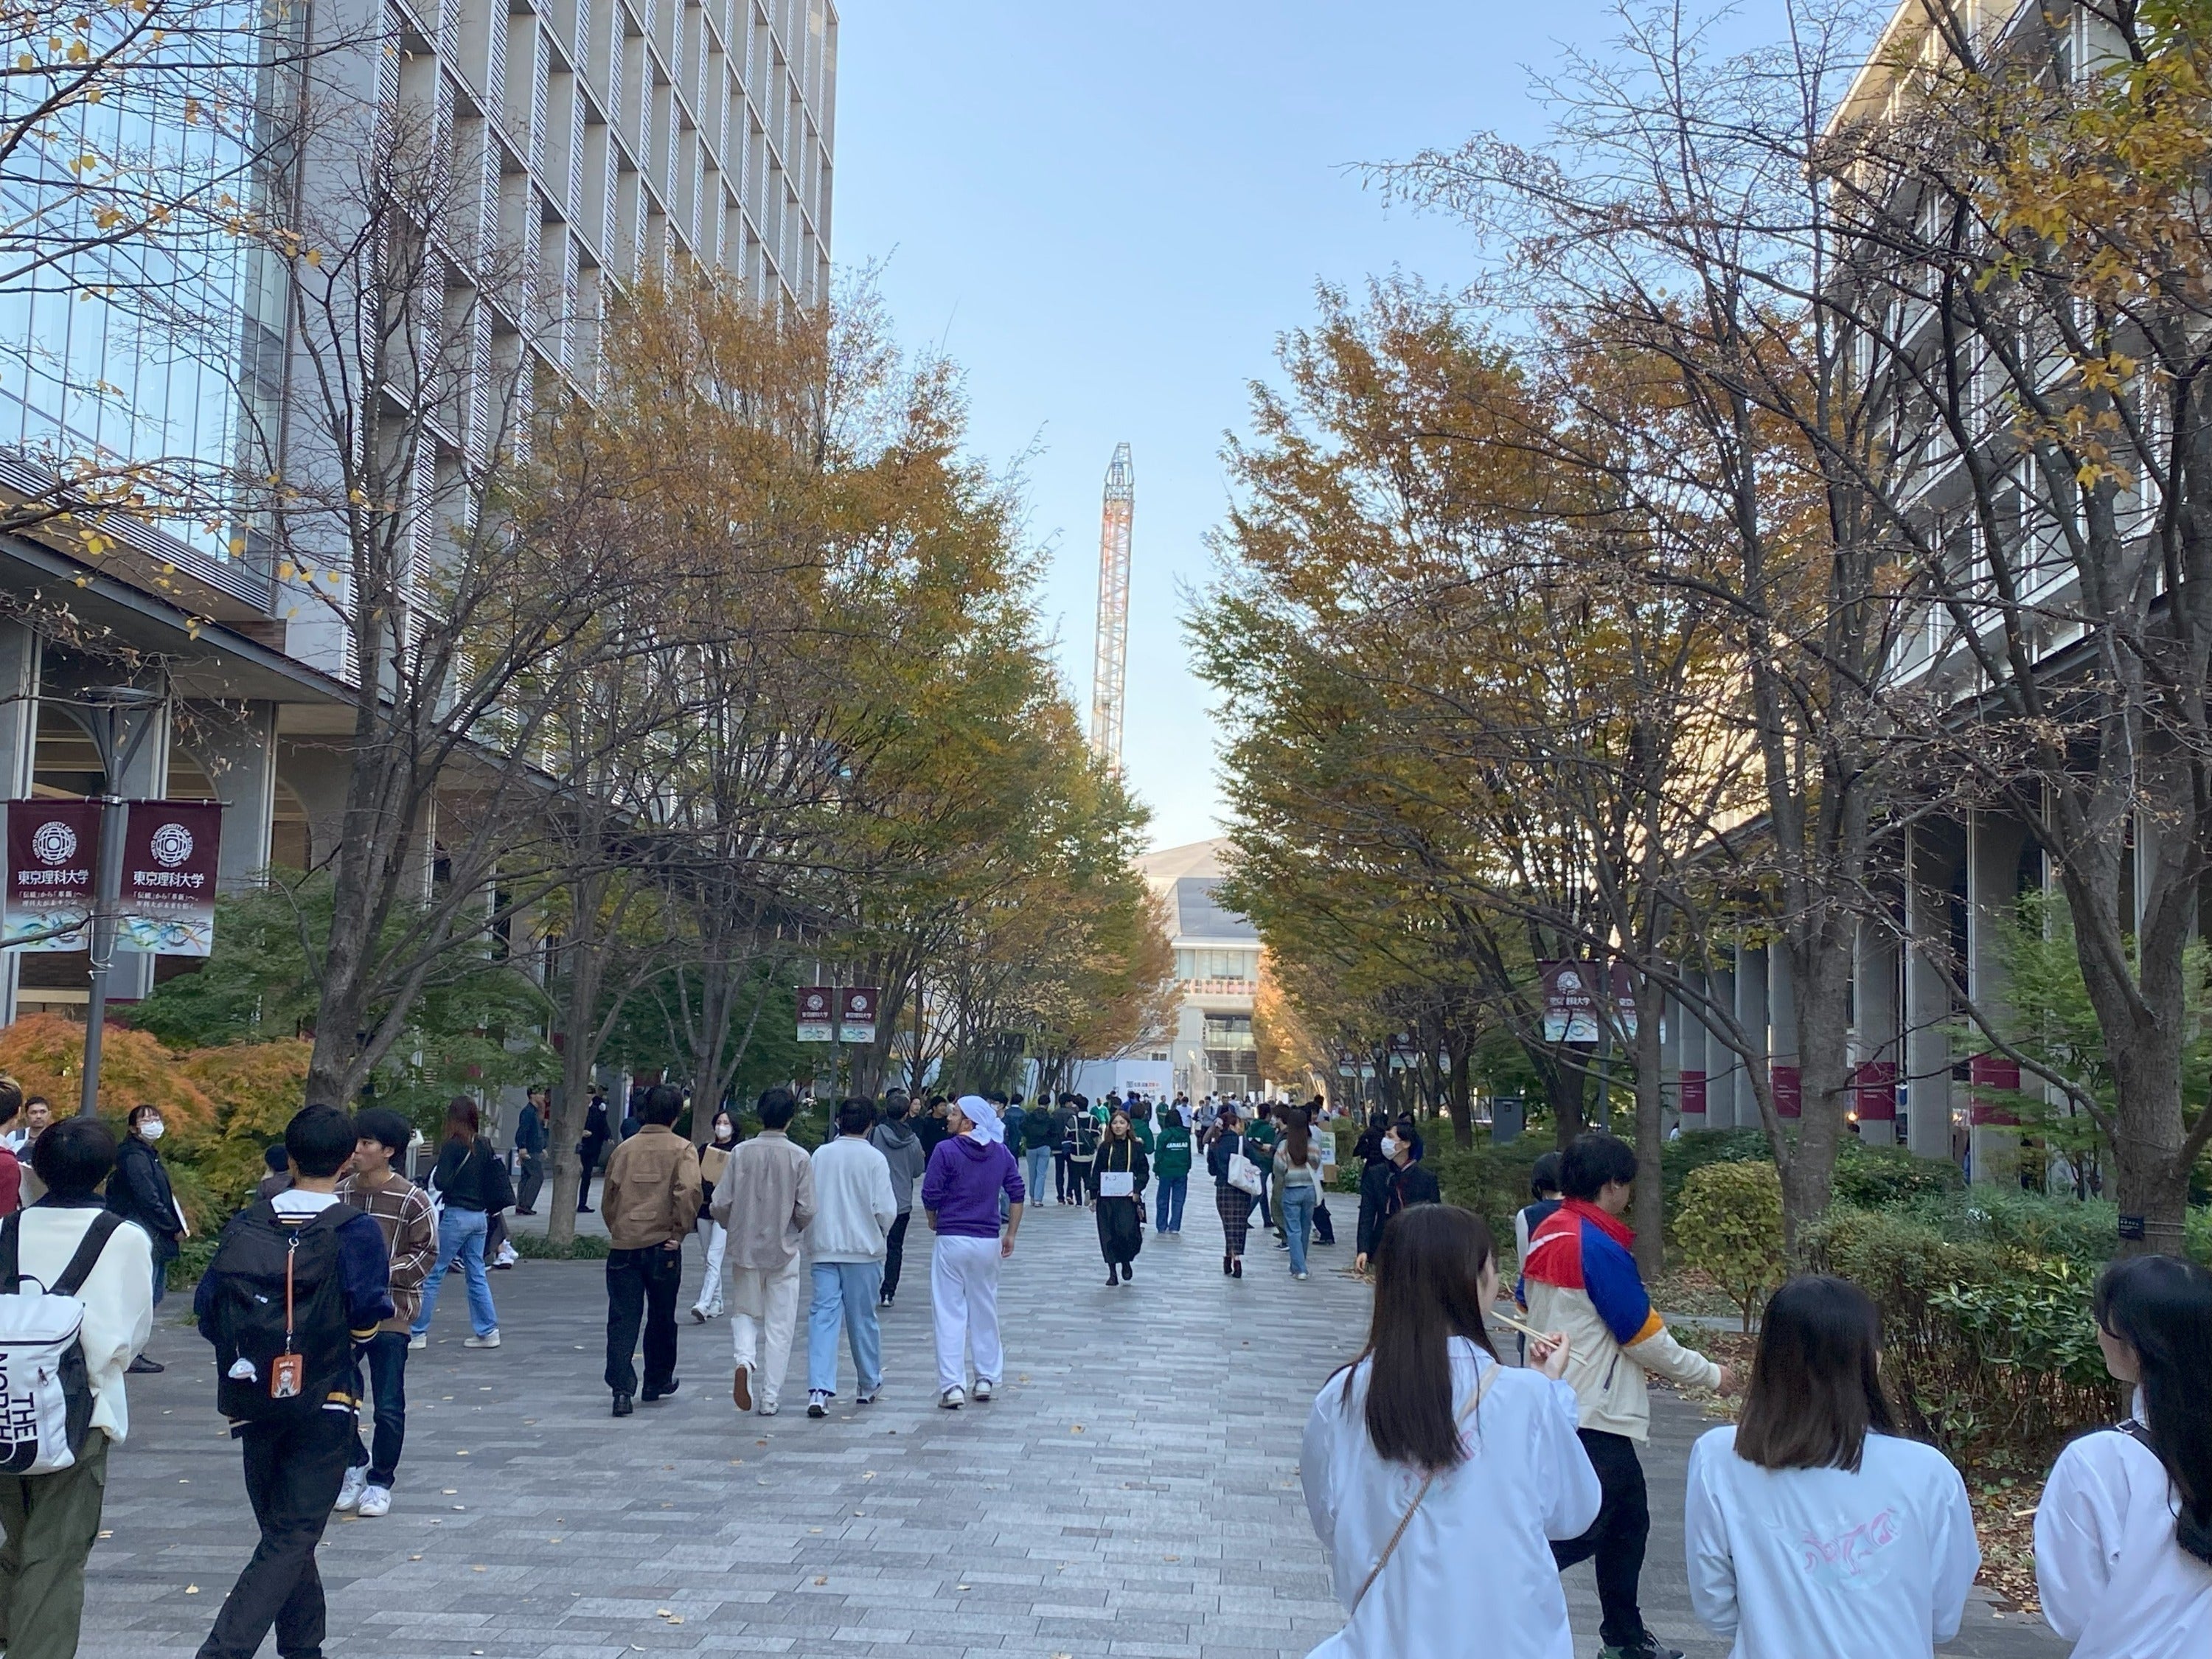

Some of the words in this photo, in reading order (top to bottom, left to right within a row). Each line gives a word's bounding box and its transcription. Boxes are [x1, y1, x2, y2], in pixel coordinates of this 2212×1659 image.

[18, 869, 88, 885] 東京理科大学
[133, 871, 204, 888] 東京理科大学
[11, 1392, 37, 1439] THE
